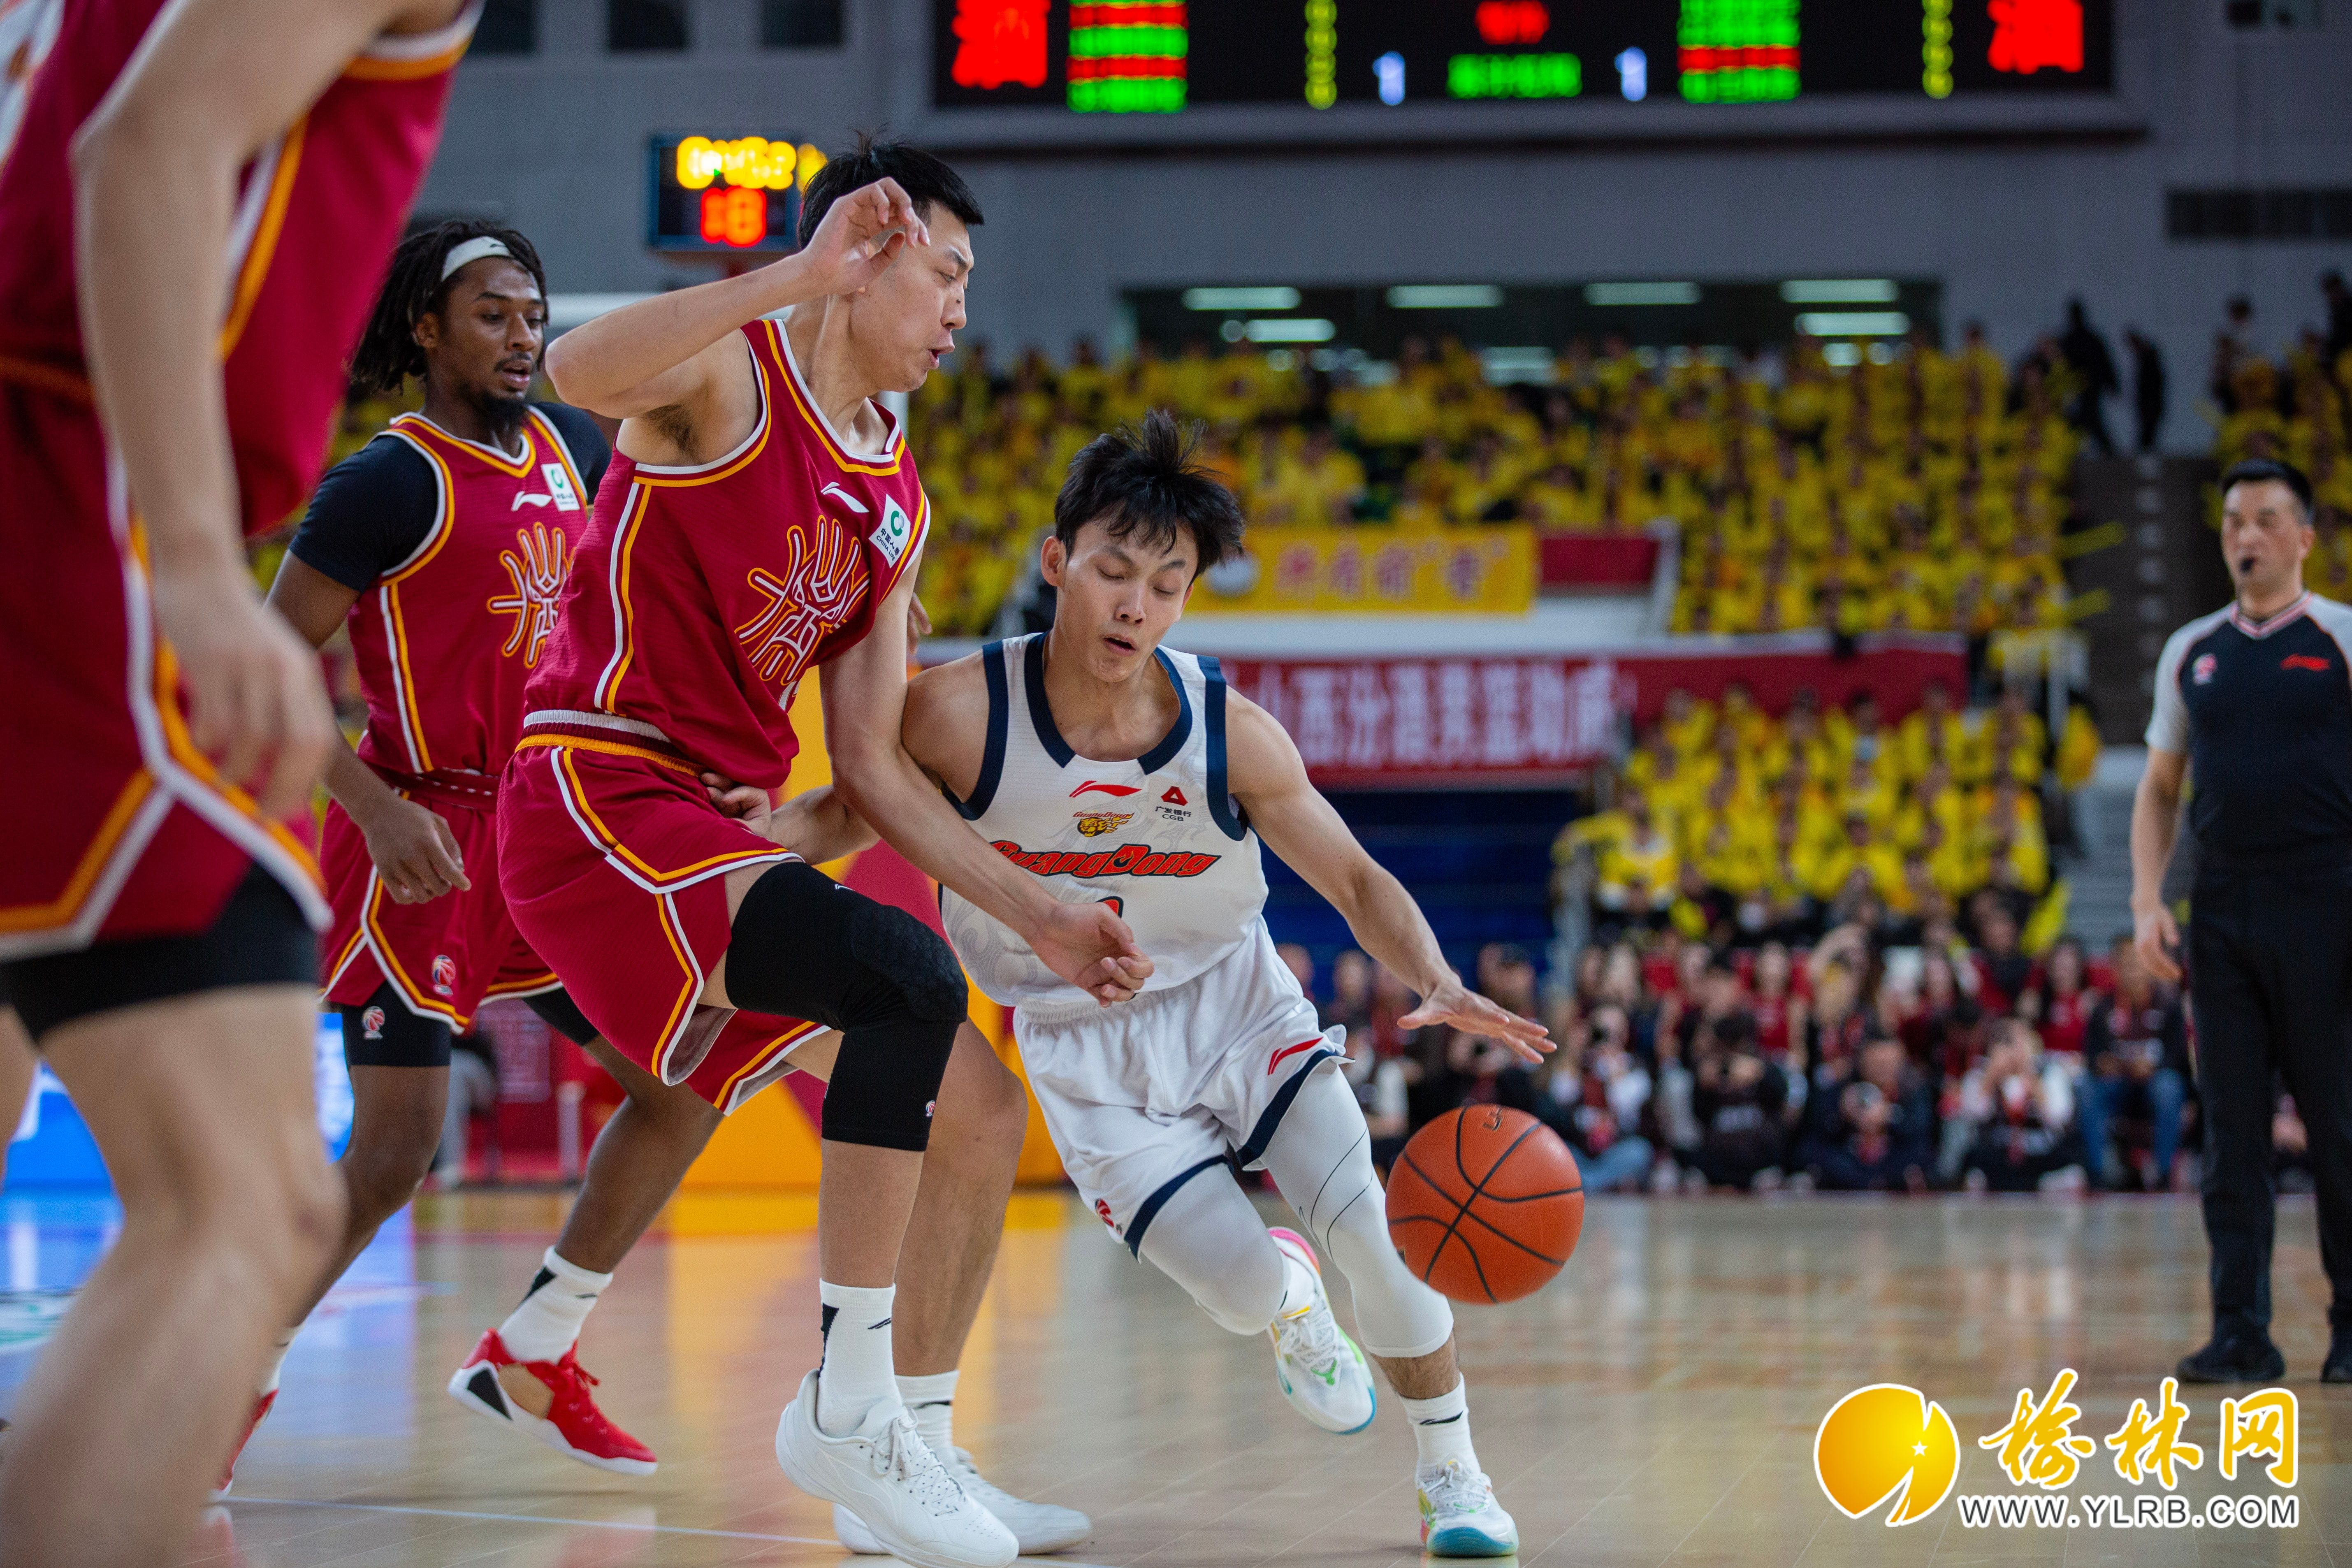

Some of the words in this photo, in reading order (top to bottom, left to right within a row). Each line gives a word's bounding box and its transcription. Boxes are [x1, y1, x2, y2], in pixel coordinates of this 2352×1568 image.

[876, 535, 888, 552] CHINA
[881, 527, 900, 556] 中国人寿
[1155, 806, 1192, 817] 广发银行
